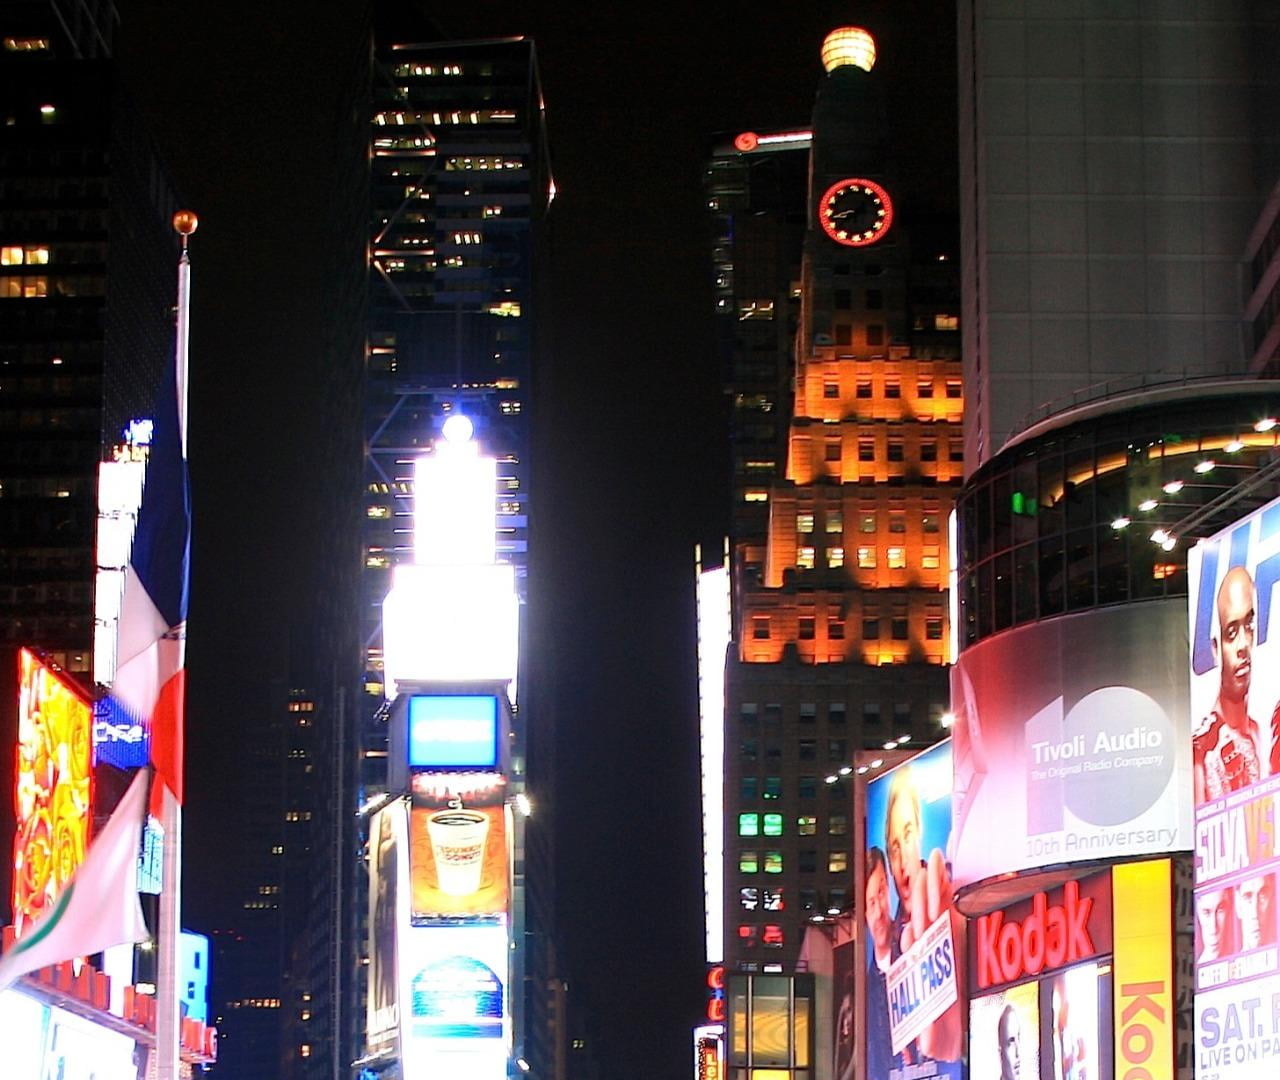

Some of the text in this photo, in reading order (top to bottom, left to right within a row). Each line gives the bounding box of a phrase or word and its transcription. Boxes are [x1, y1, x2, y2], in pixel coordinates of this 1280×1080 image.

[1032, 726, 1163, 764] Tivoli Audio
[1084, 759, 1112, 772] Radio
[1065, 826, 1178, 851] Anniversary
[1196, 805, 1249, 884] SILVA
[976, 879, 1096, 989] Kodak
[890, 971, 921, 1027] HALL
[921, 938, 952, 998] PASS
[1200, 998, 1263, 1048] SAT.
[1200, 1047, 1231, 1070] LIVE
[1235, 1042, 1257, 1063] ON
